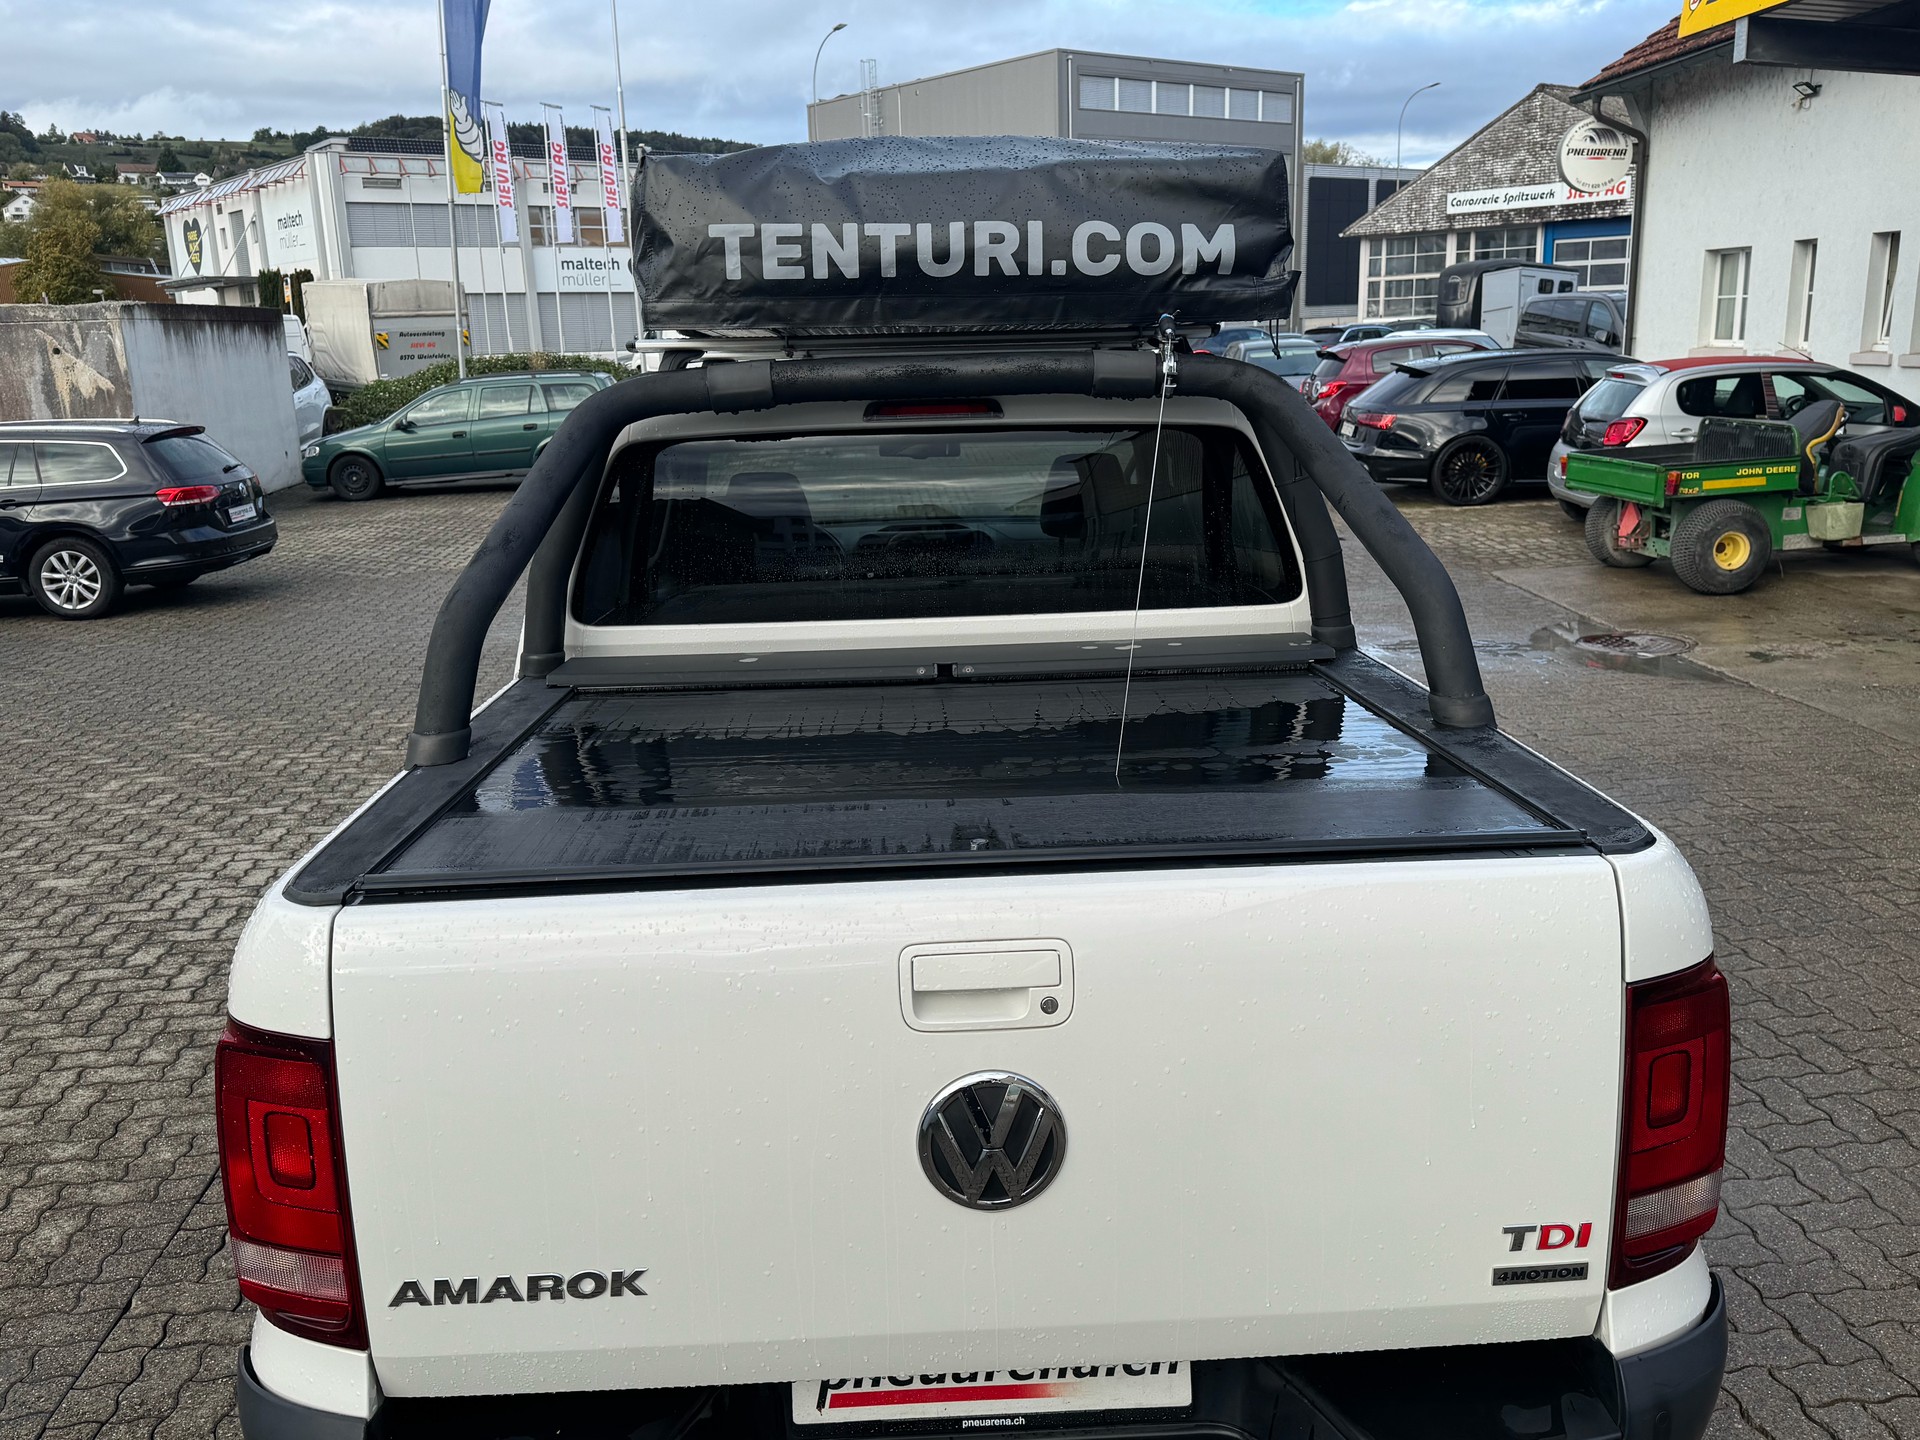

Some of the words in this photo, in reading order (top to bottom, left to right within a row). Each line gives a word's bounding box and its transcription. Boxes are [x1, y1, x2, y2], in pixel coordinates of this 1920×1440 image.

[493, 140, 507, 164] AG
[551, 142, 564, 166] AG
[601, 143, 614, 167] AG
[1566, 148, 1628, 156] PNEUARENA
[496, 168, 513, 208] SIEVI
[553, 170, 569, 209] SIEVI
[603, 171, 619, 209] SIEVI
[1450, 194, 1500, 208] Carrosserie
[1503, 189, 1556, 205] Spritzwerk
[277, 210, 303, 231] maltech
[708, 220, 1236, 281] TENTURI.COM
[561, 257, 620, 270] maltech
[1736, 467, 1763, 476] JOHN
[1766, 465, 1797, 474] DEERE
[1502, 1221, 1593, 1252] TDI
[1497, 1266, 1585, 1282] 4MOTION
[388, 1267, 650, 1307] AMAROK
[962, 1416, 1026, 1428] pneuarena.ch
